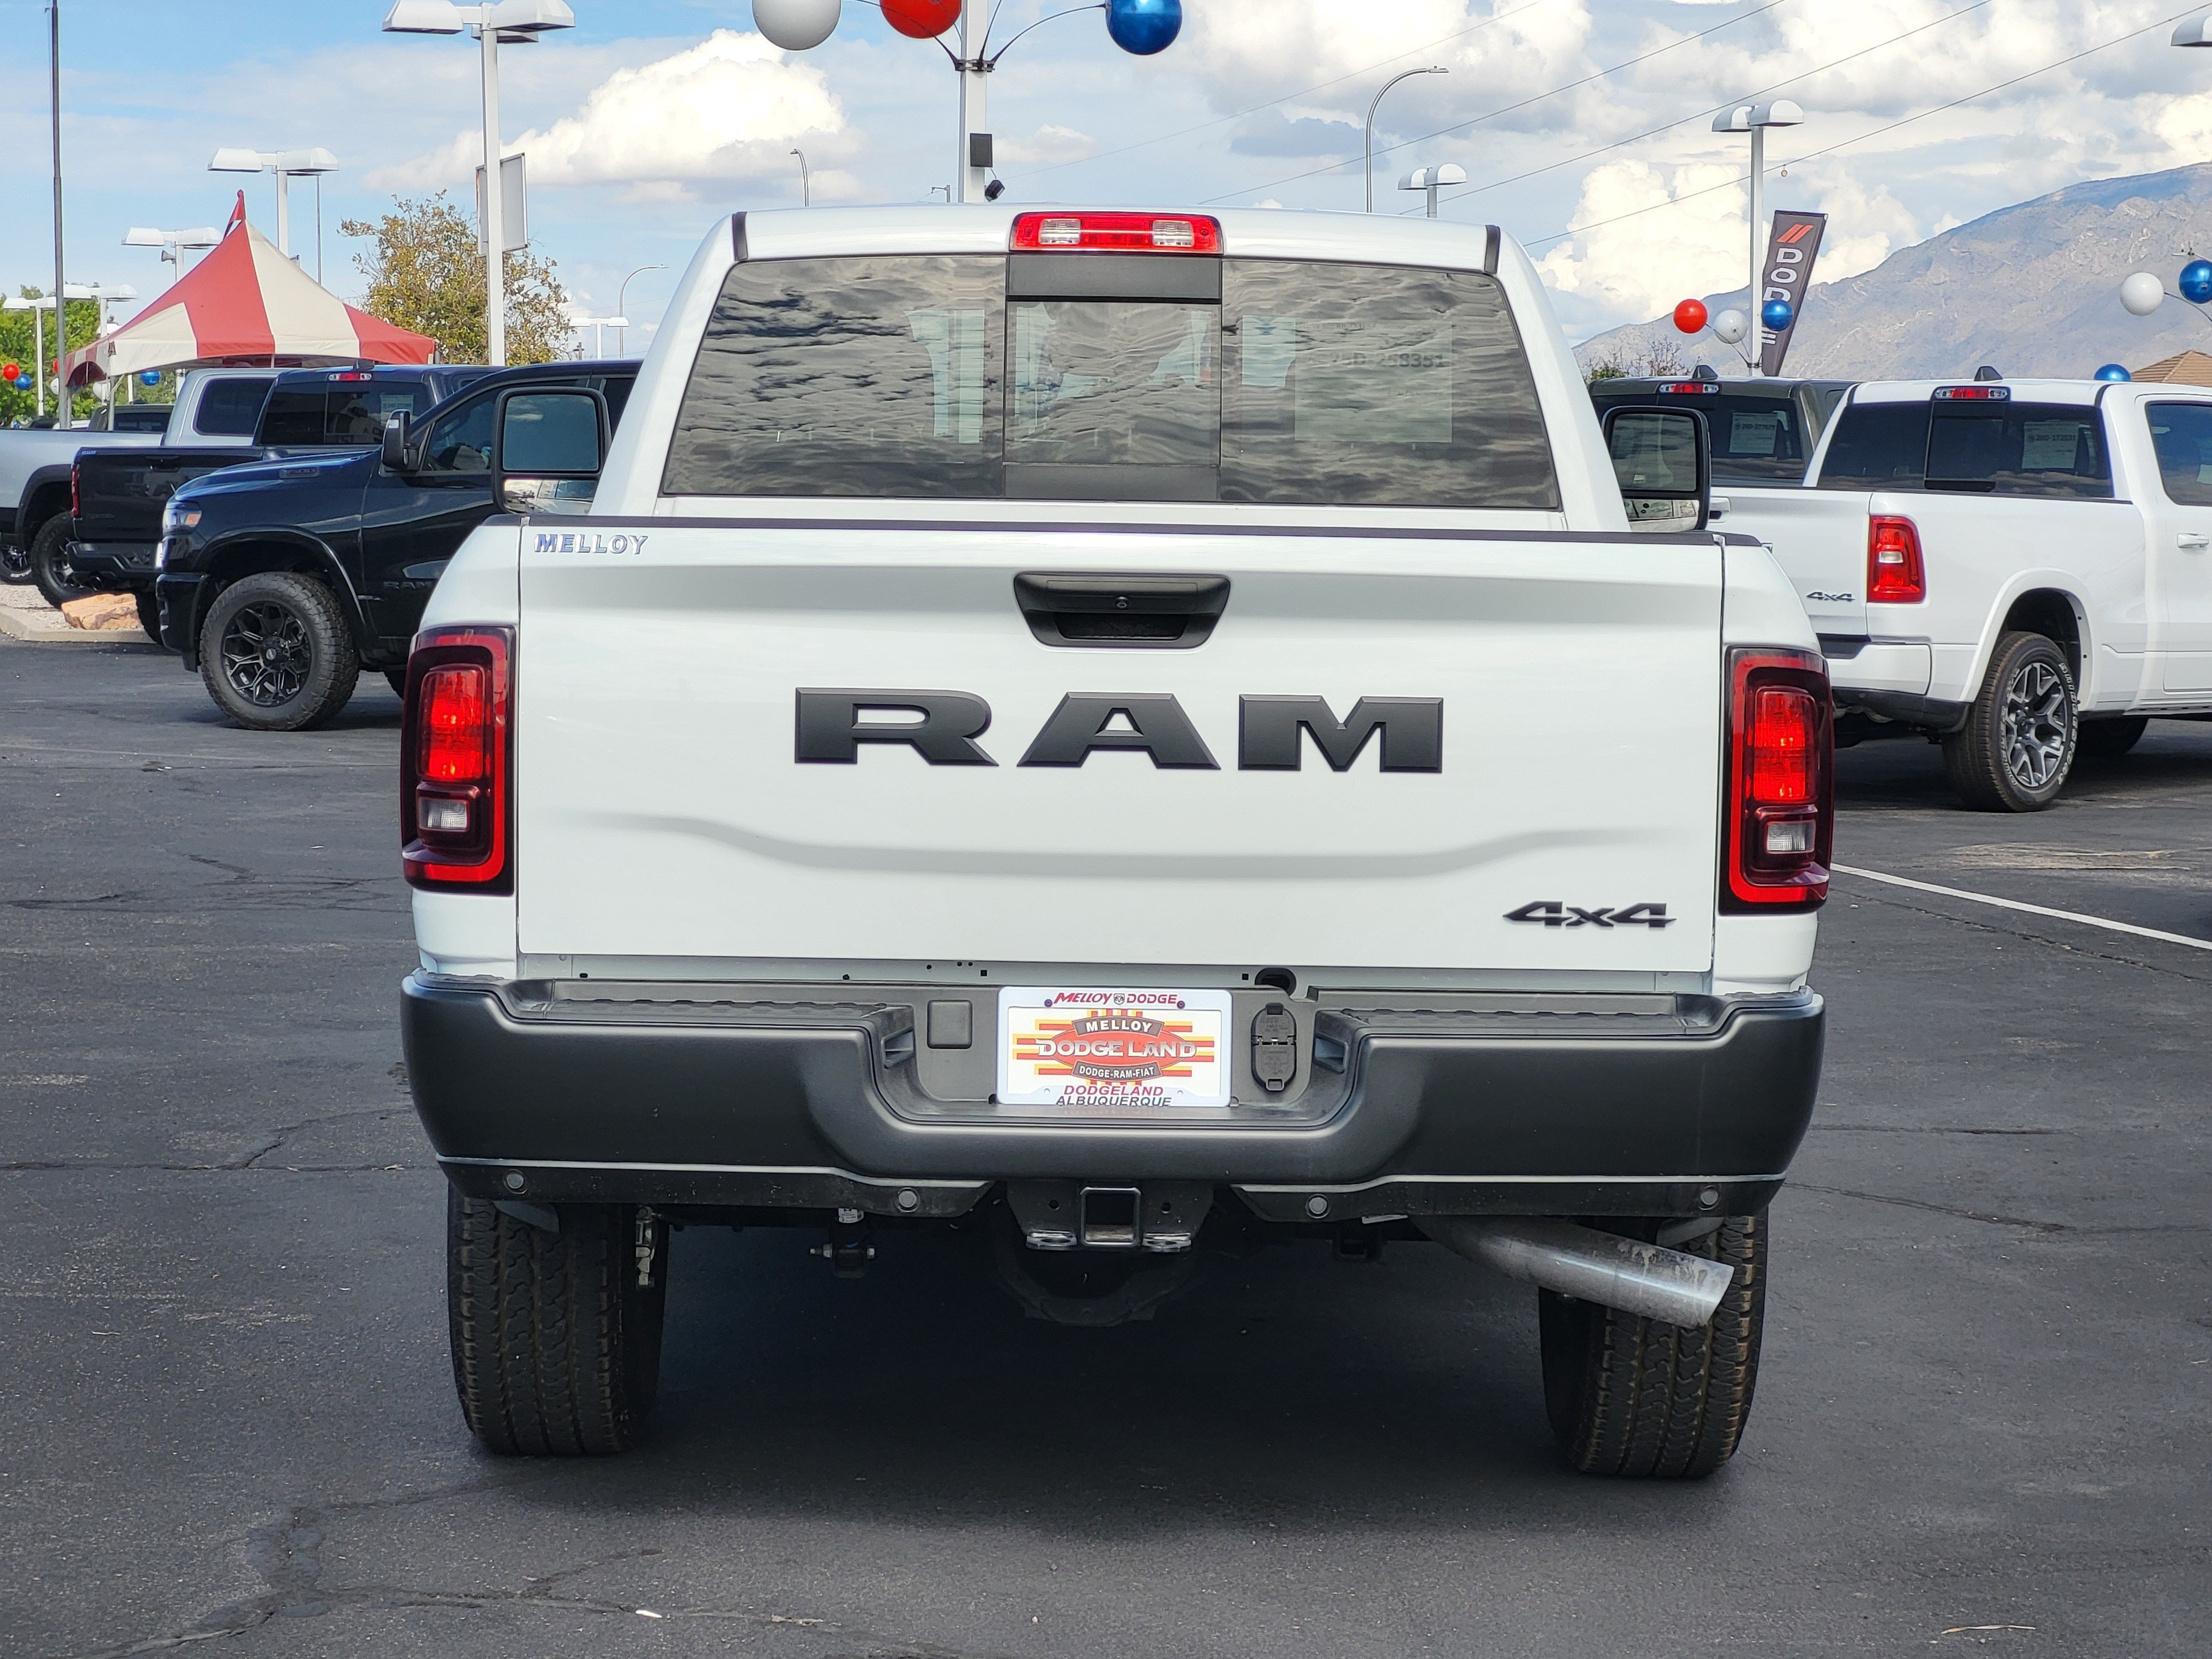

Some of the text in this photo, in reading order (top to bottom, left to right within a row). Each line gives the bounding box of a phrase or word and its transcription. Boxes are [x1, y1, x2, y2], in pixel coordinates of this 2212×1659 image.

[1762, 248, 1803, 345] DODE
[534, 534, 648, 555] MELLOY
[383, 581, 432, 589] RAM
[1806, 591, 1856, 602] 4x4
[795, 687, 1444, 773] RAM
[1503, 900, 1678, 928] 4x4
[1053, 992, 1177, 1005] MELLOY DODGE
[1086, 1019, 1152, 1033] MELLOY
[1035, 1038, 1197, 1058] DODGE LAND
[1063, 1085, 1164, 1097] DODGELAND
[1055, 1095, 1172, 1107] ALBUQUERQUE
